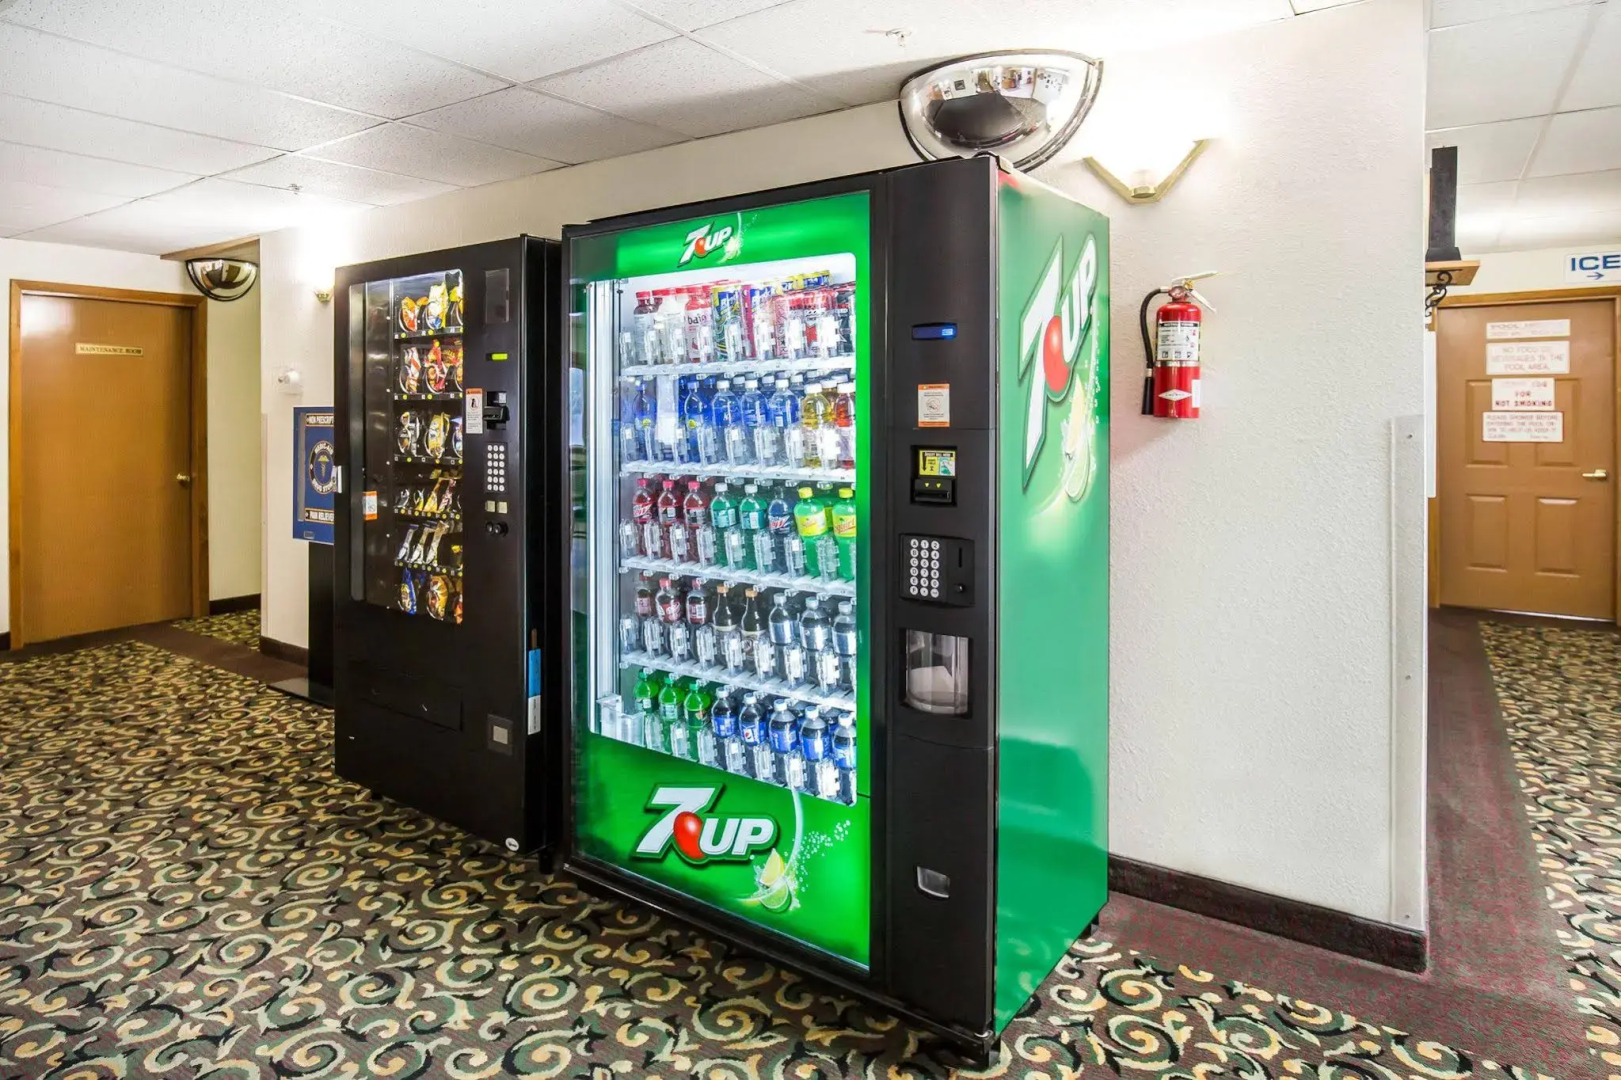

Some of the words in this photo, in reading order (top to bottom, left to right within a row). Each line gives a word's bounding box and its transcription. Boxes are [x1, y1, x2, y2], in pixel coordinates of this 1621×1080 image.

[679, 223, 733, 265] 7UP
[1571, 254, 1621, 271] ICE
[1019, 238, 1097, 473] 7UP
[634, 785, 776, 858] 7UP
